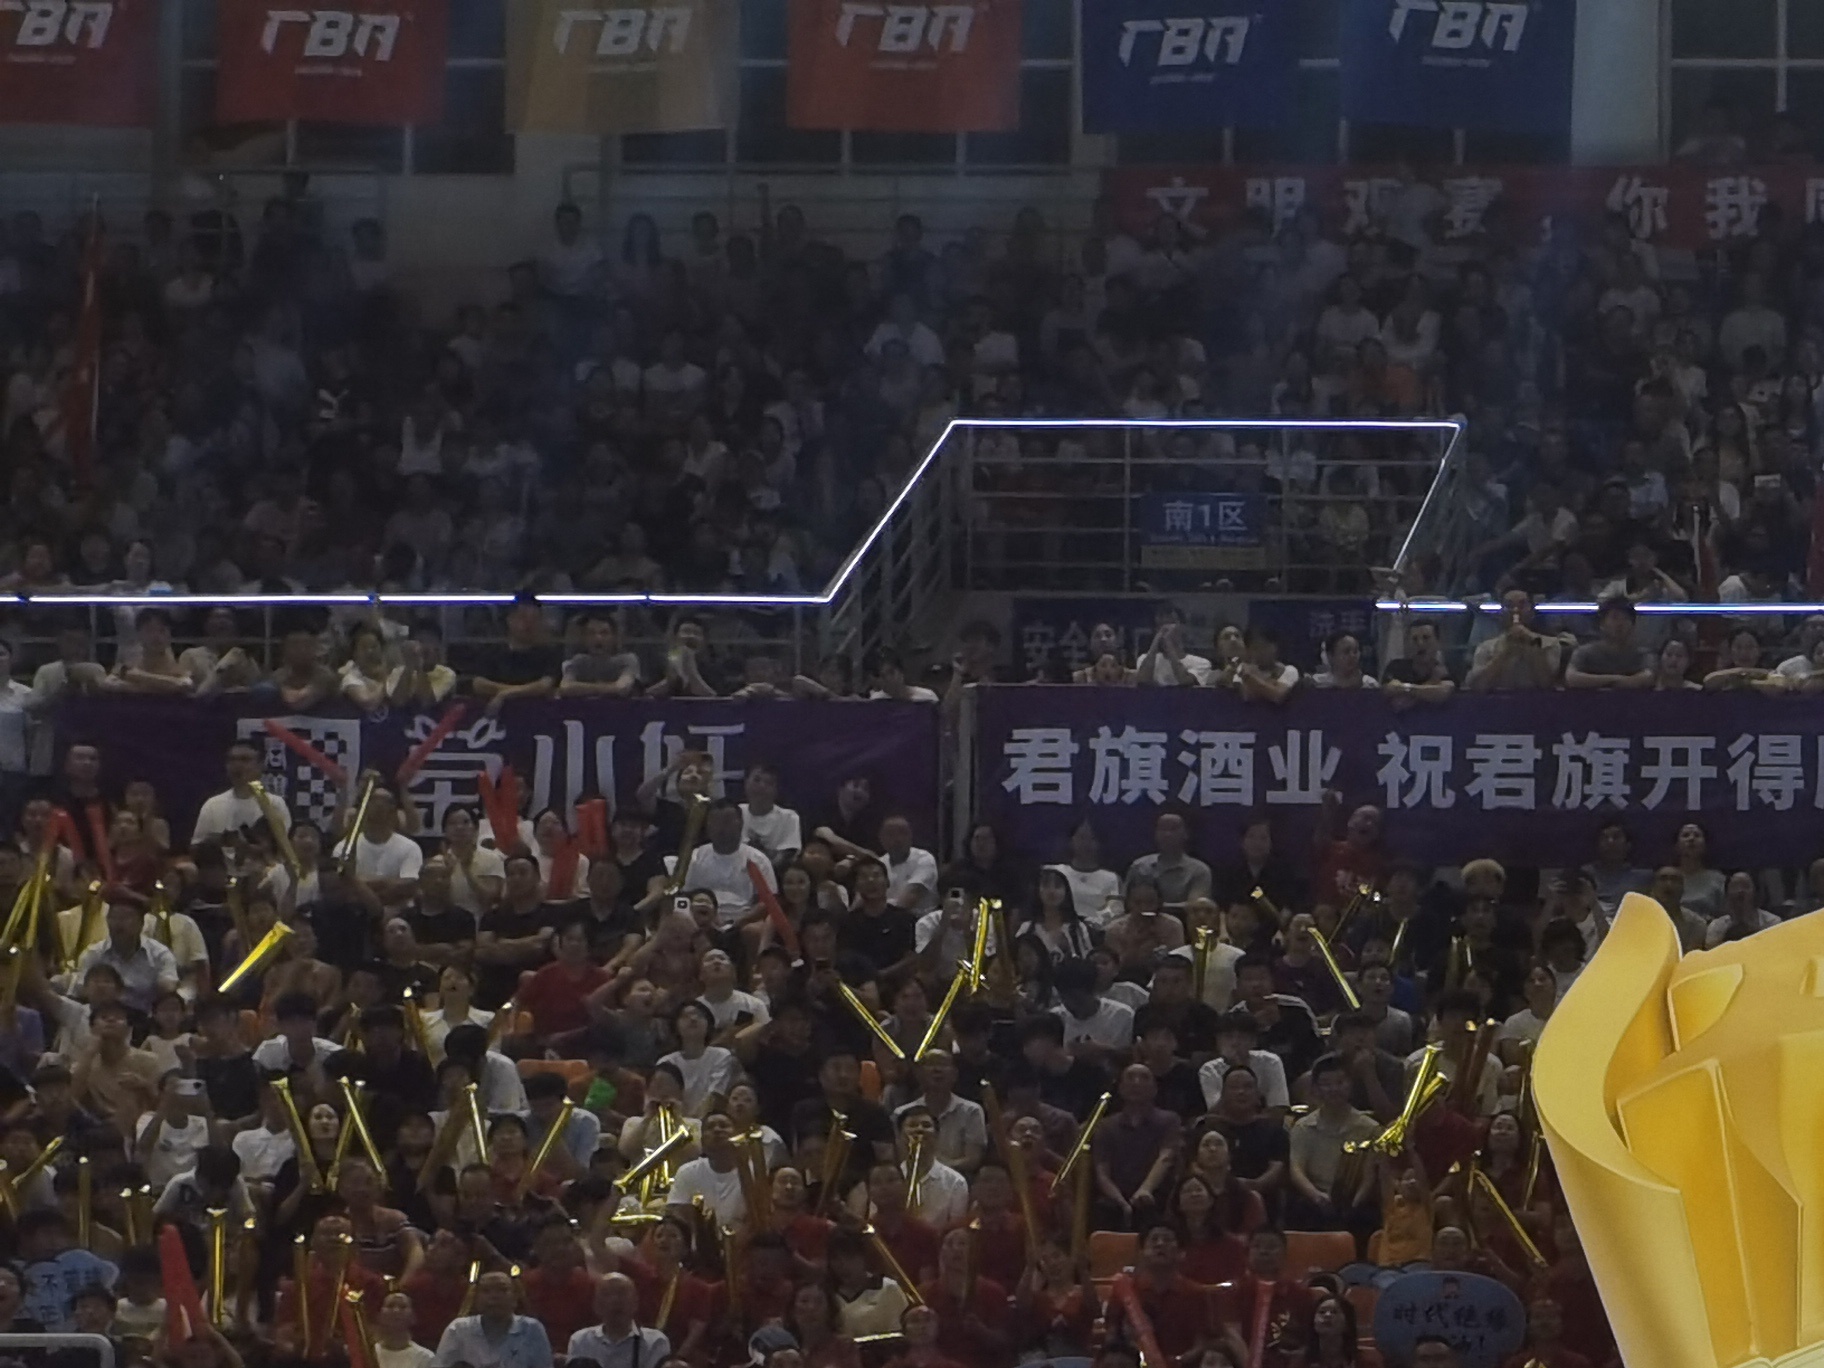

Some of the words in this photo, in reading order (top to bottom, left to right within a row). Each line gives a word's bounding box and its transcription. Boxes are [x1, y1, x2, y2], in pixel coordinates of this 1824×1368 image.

[1163, 501, 1248, 532] 南1区
[1002, 726, 1343, 806] 君旗酒业
